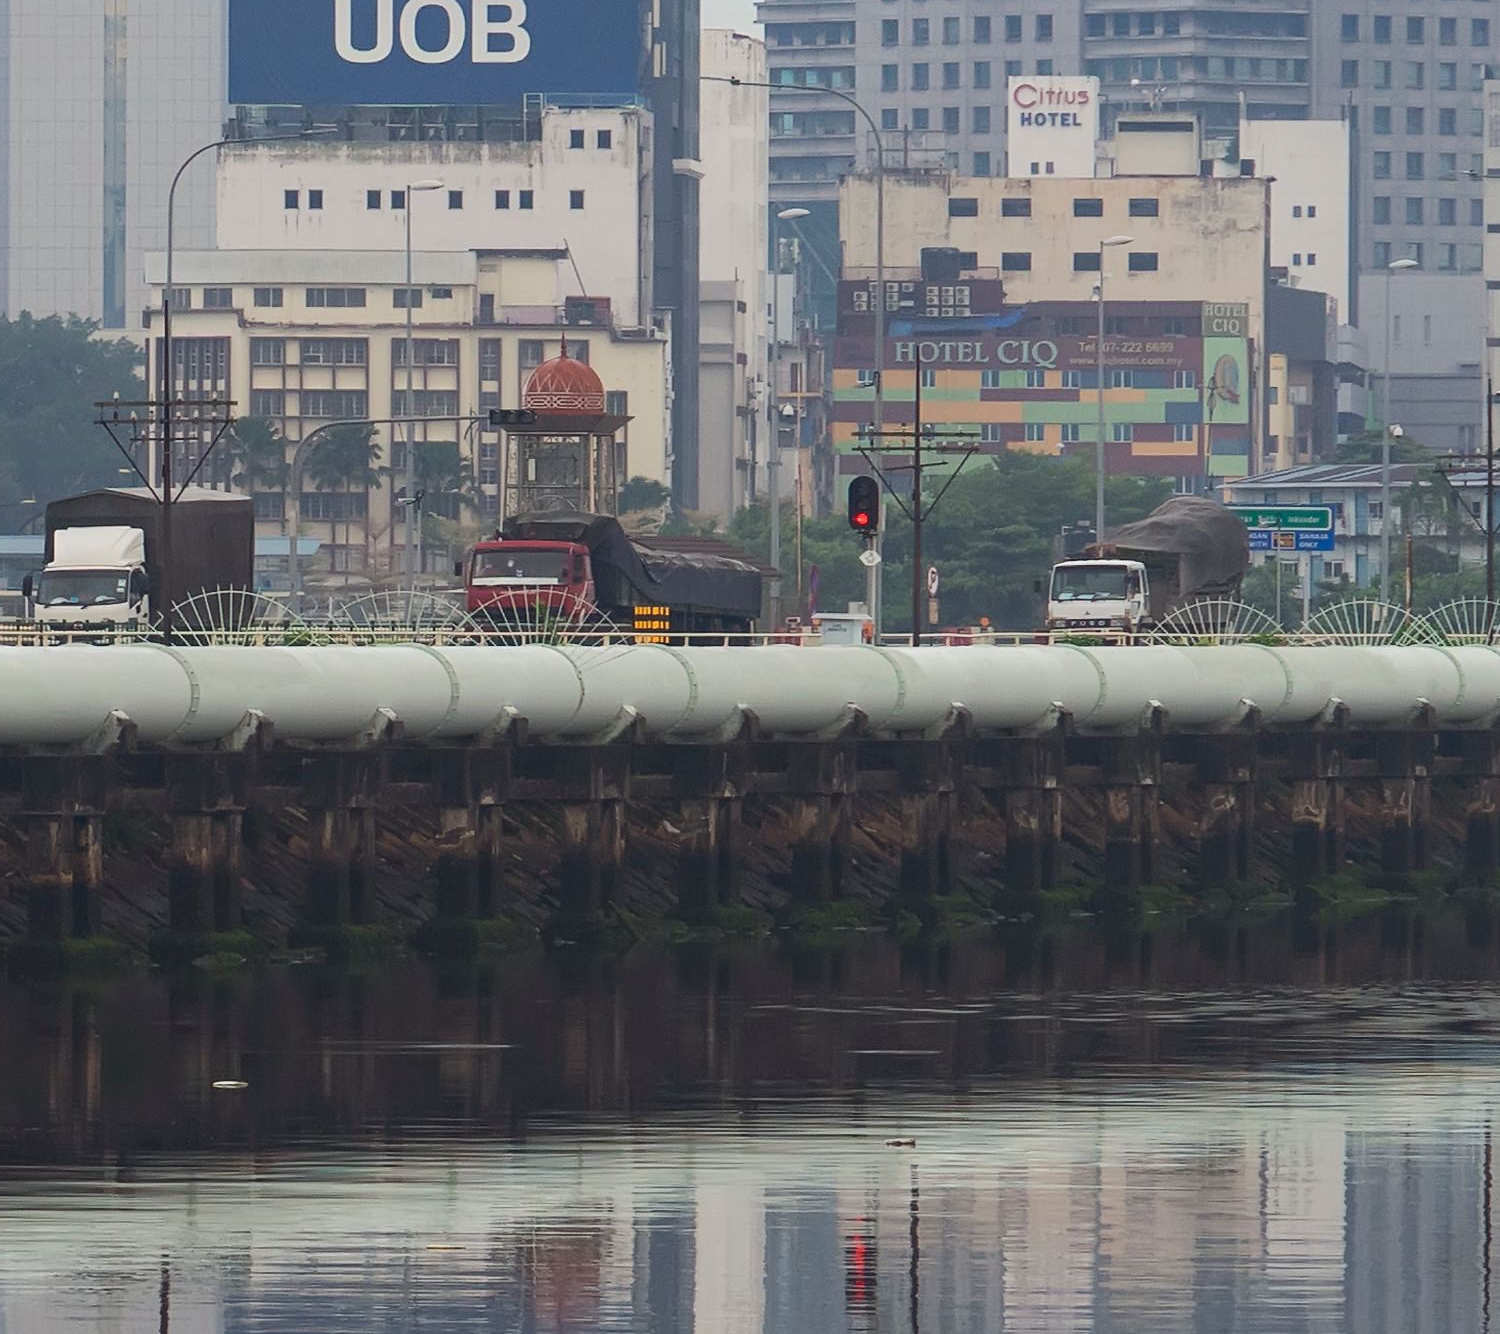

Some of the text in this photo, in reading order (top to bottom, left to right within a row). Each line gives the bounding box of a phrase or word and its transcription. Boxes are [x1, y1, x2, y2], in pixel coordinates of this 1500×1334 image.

[1014, 83, 1089, 108] Citrus
[1021, 112, 1082, 126] HOTEL
[895, 340, 1058, 368] HOTEL CIQ
